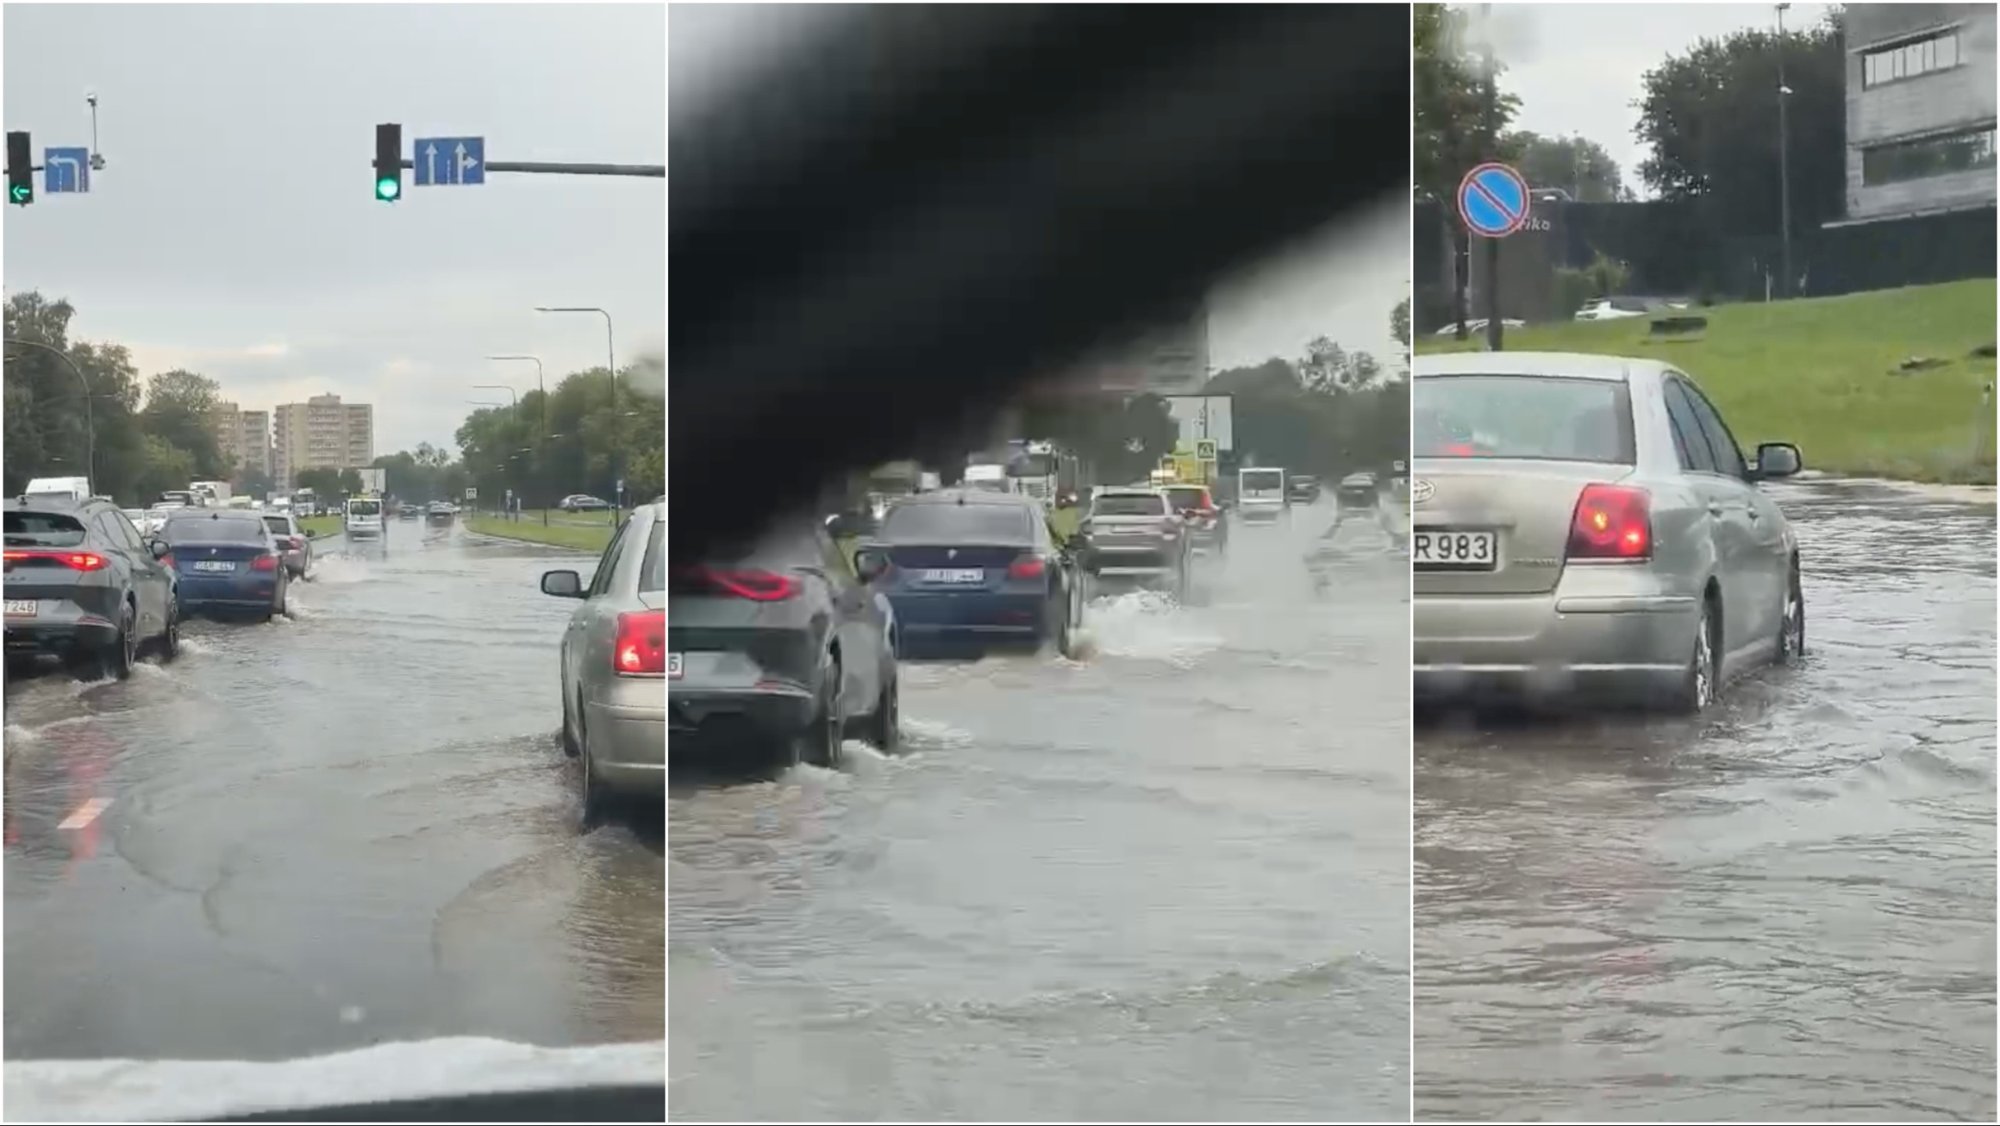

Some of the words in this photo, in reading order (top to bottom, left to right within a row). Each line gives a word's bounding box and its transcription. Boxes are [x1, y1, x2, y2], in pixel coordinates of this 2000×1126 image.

[1414, 535, 1431, 559] R
[1438, 535, 1488, 559] 983
[12, 601, 34, 611] 246
